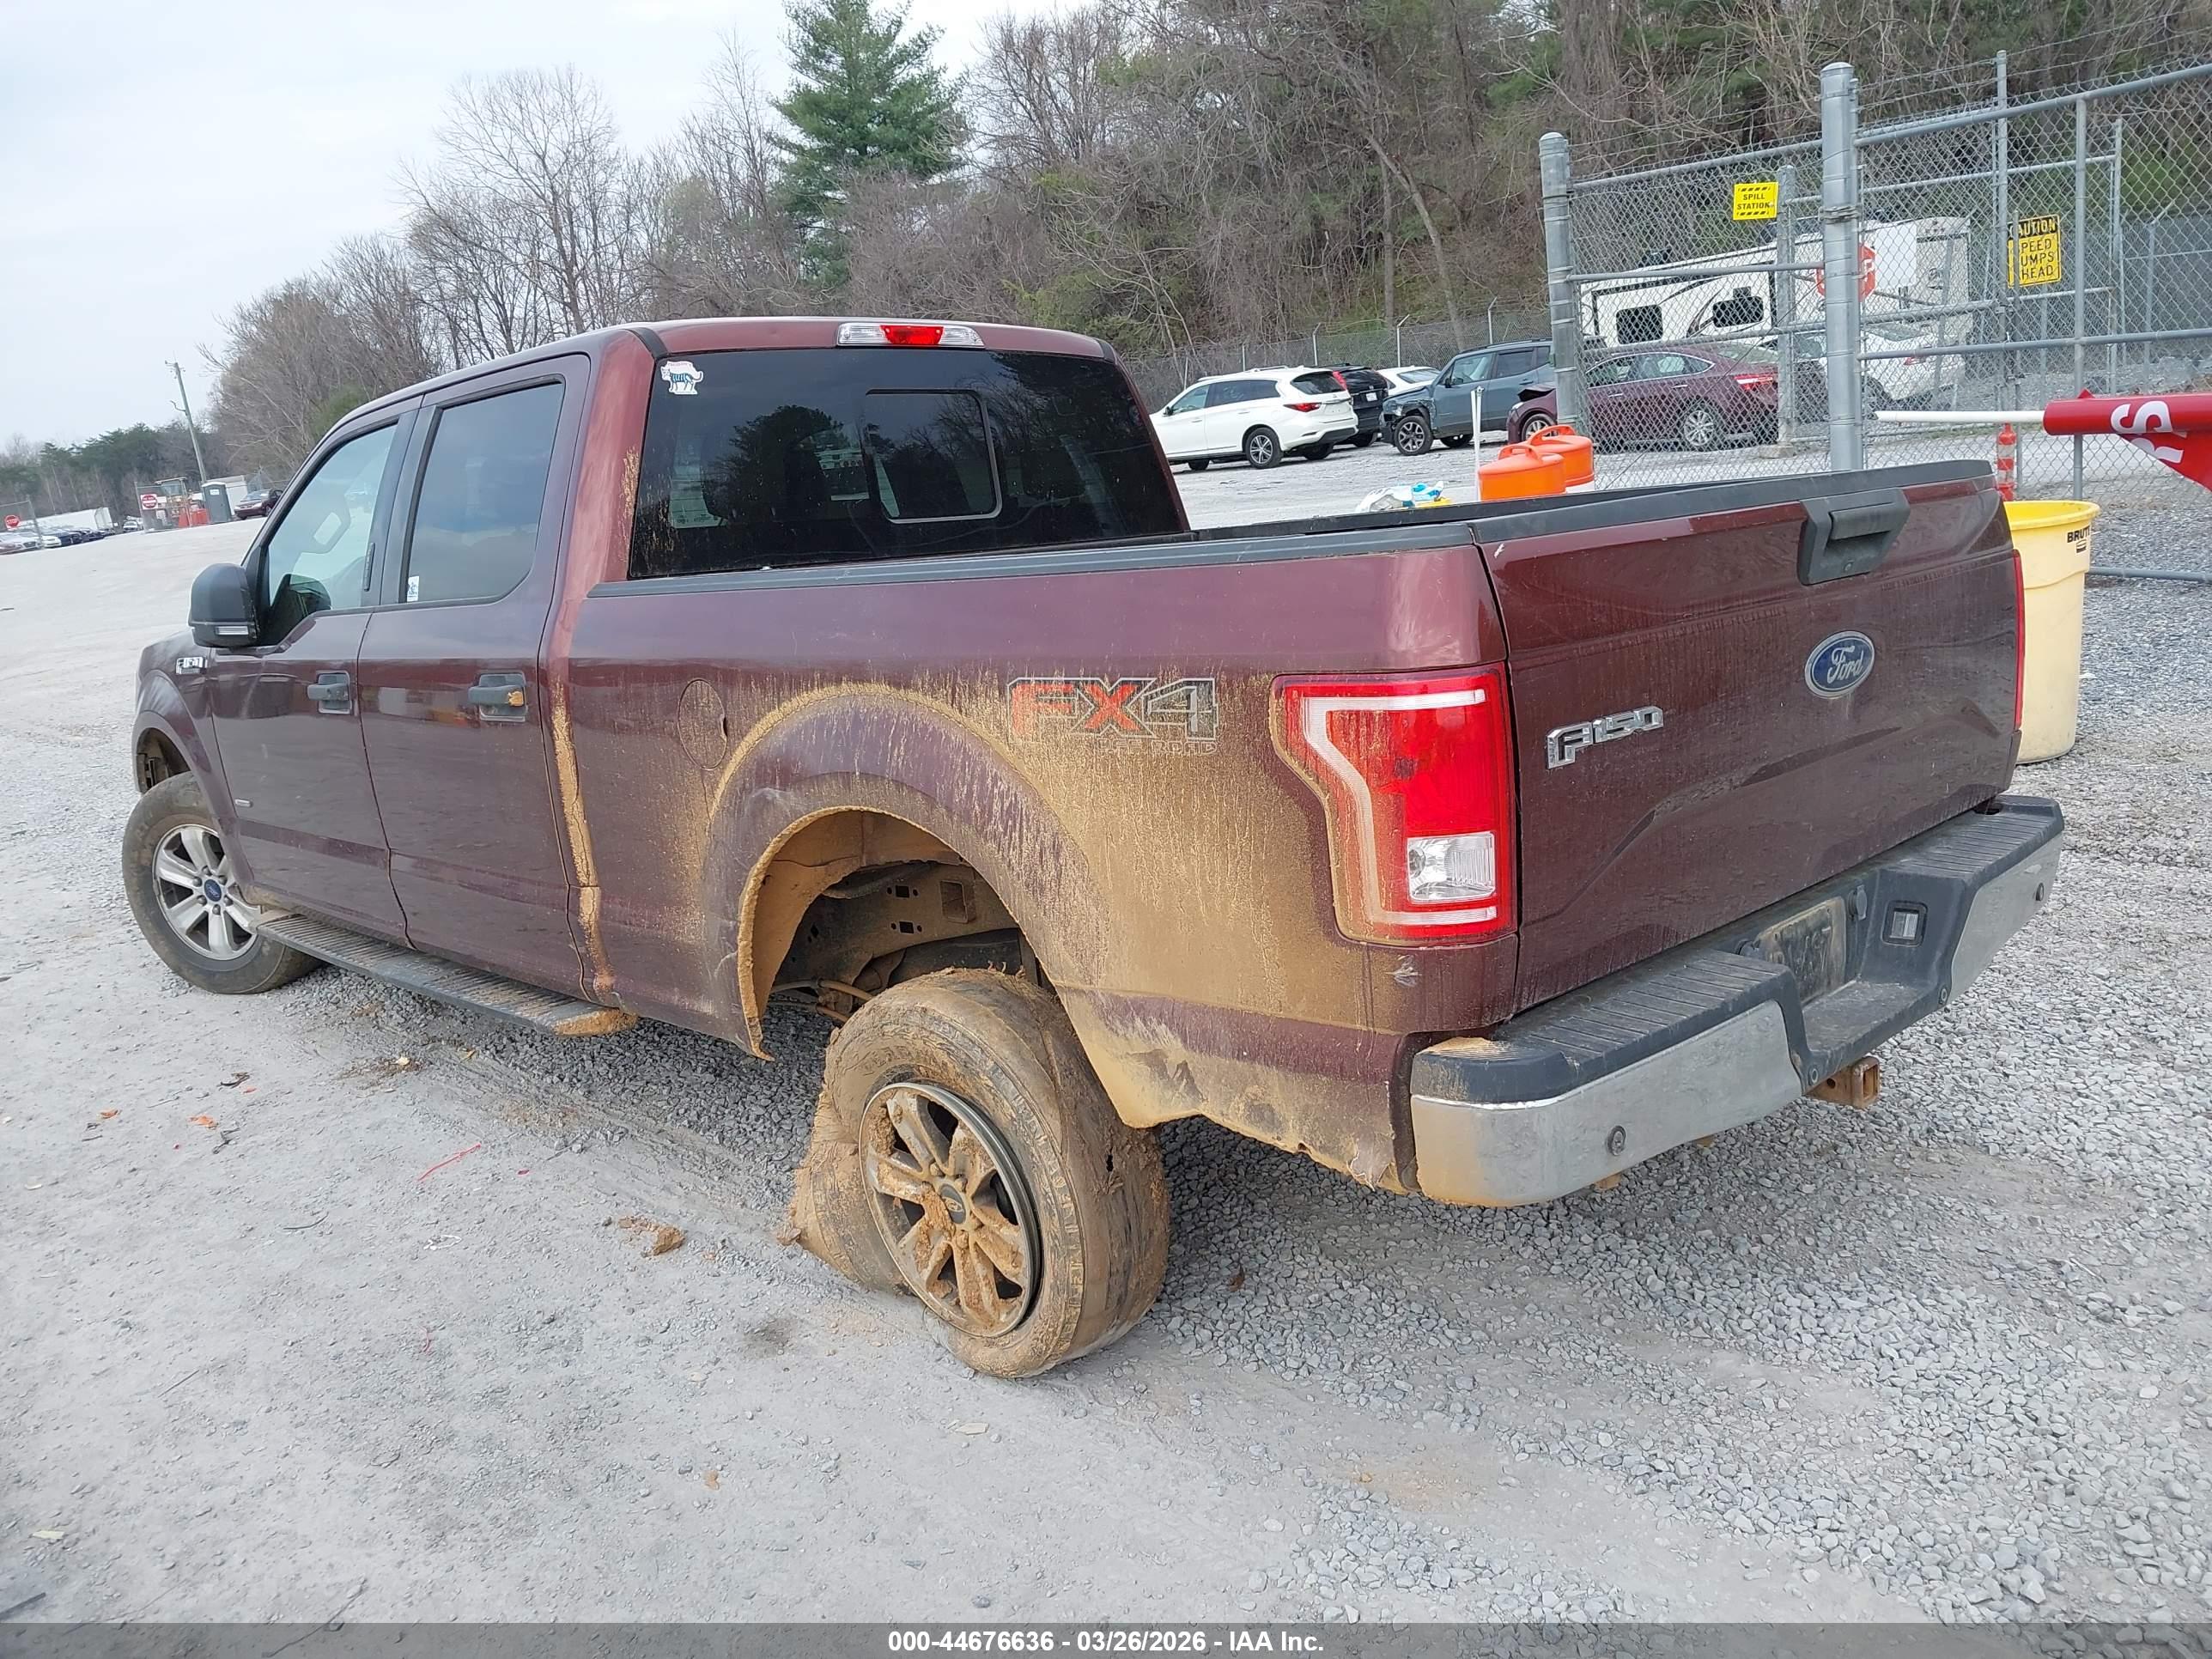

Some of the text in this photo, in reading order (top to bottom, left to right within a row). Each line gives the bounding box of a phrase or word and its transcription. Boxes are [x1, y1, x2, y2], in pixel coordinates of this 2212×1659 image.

[2021, 239, 2052, 253] PEED
[2021, 252, 2054, 267] UMPS
[2021, 265, 2053, 280] HEAD
[1827, 646, 1863, 684] Ford
[1007, 678, 1218, 744] FX4
[1151, 740, 1218, 754] ROAD
